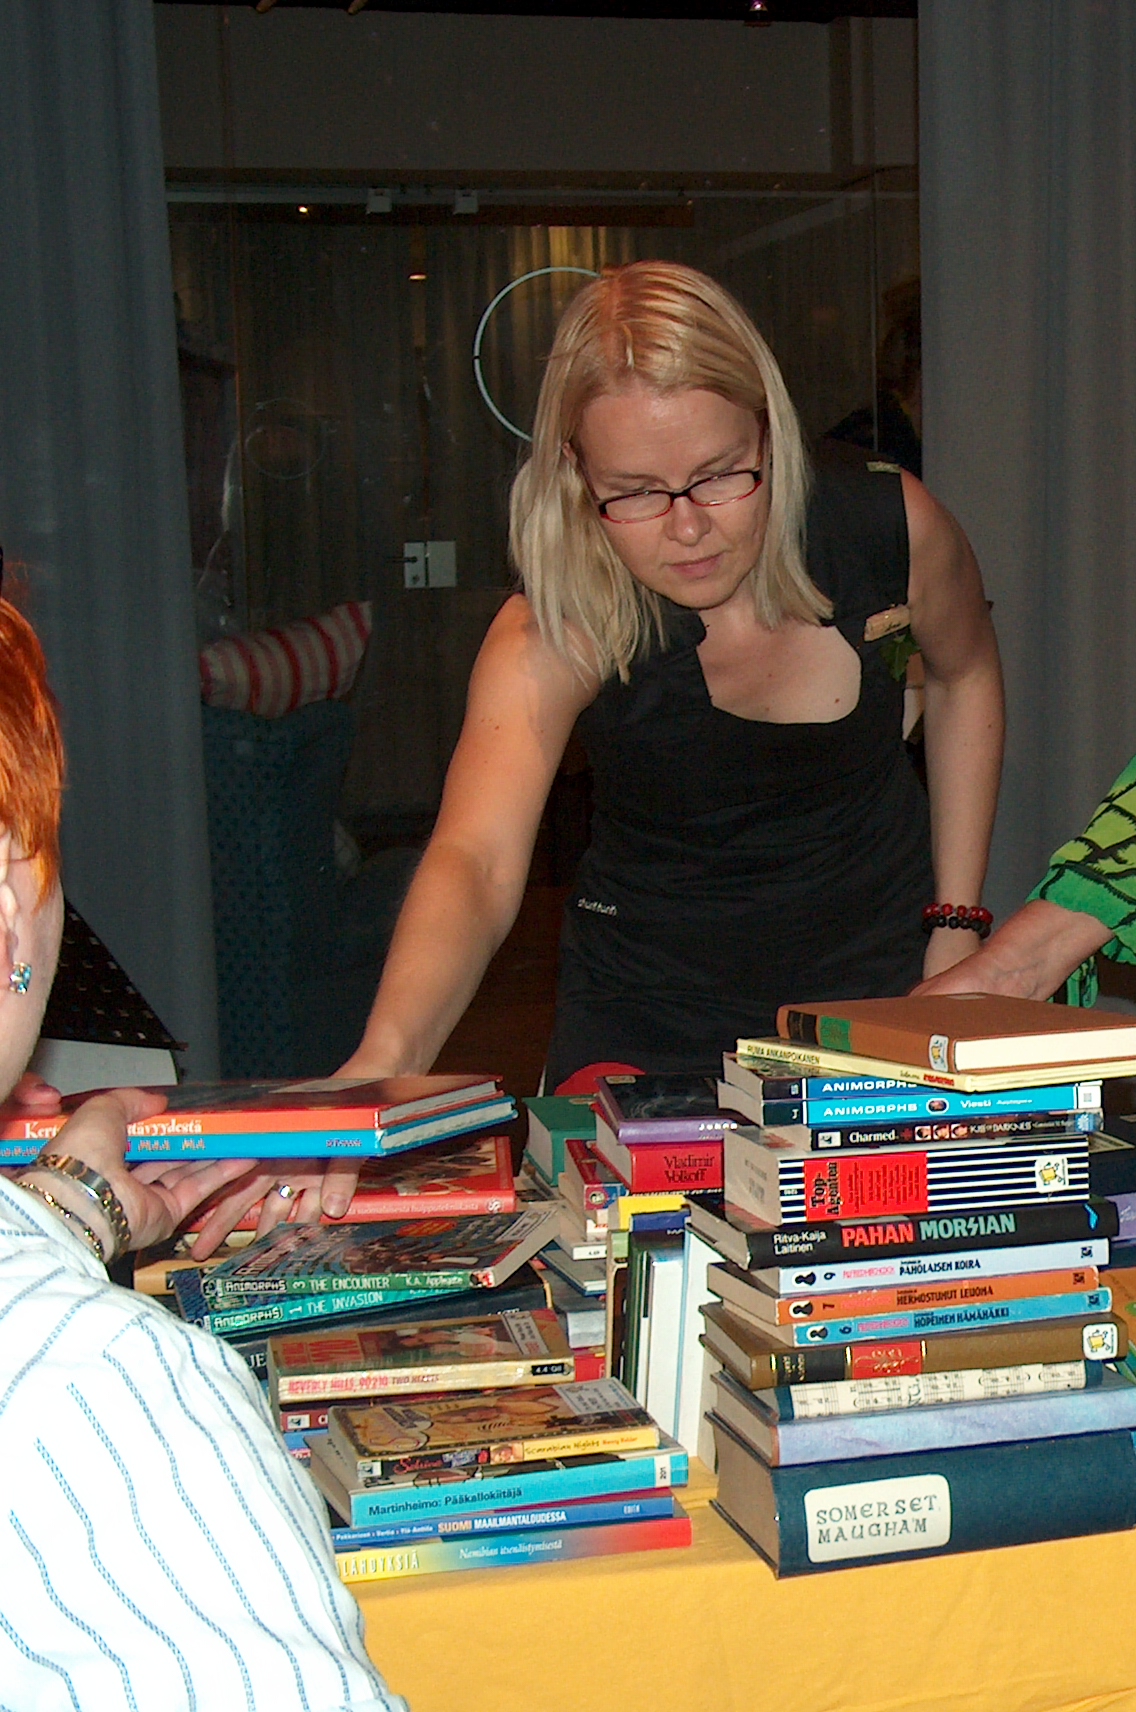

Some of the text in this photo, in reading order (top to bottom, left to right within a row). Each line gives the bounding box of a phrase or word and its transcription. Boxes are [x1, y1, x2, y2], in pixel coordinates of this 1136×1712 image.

[823, 1103, 918, 1117] ANIMORPHS
[849, 1129, 896, 1143] Charmed
[664, 1153, 715, 1169] Vladimir
[664, 1168, 707, 1183] Volkoff
[826, 1161, 841, 1215] Agenten
[773, 1230, 827, 1245] Ritva-Kaija
[841, 1214, 1016, 1248] PAHAN MORSIAN
[774, 1243, 814, 1255] Laitinen
[899, 1261, 952, 1276] PAHOLAISEN
[954, 1259, 981, 1271] KOIRA
[225, 1280, 286, 1292] ANIMORPHS
[310, 1279, 328, 1291] THE
[332, 1277, 390, 1290] ENCOUNTER
[214, 1308, 280, 1328] ANIMORPHS
[308, 1300, 328, 1313] THE
[332, 1292, 383, 1310] INVASION
[288, 1379, 327, 1394] BEVERLY
[368, 1499, 442, 1516] Martinheimo:
[816, 1494, 937, 1525] SOMERSET
[438, 1520, 472, 1533] SUOMI
[474, 1511, 566, 1529] MAAILMANTALOUDESSA
[818, 1518, 927, 1544] MAUGHAM
[459, 1547, 498, 1560] Namibian
